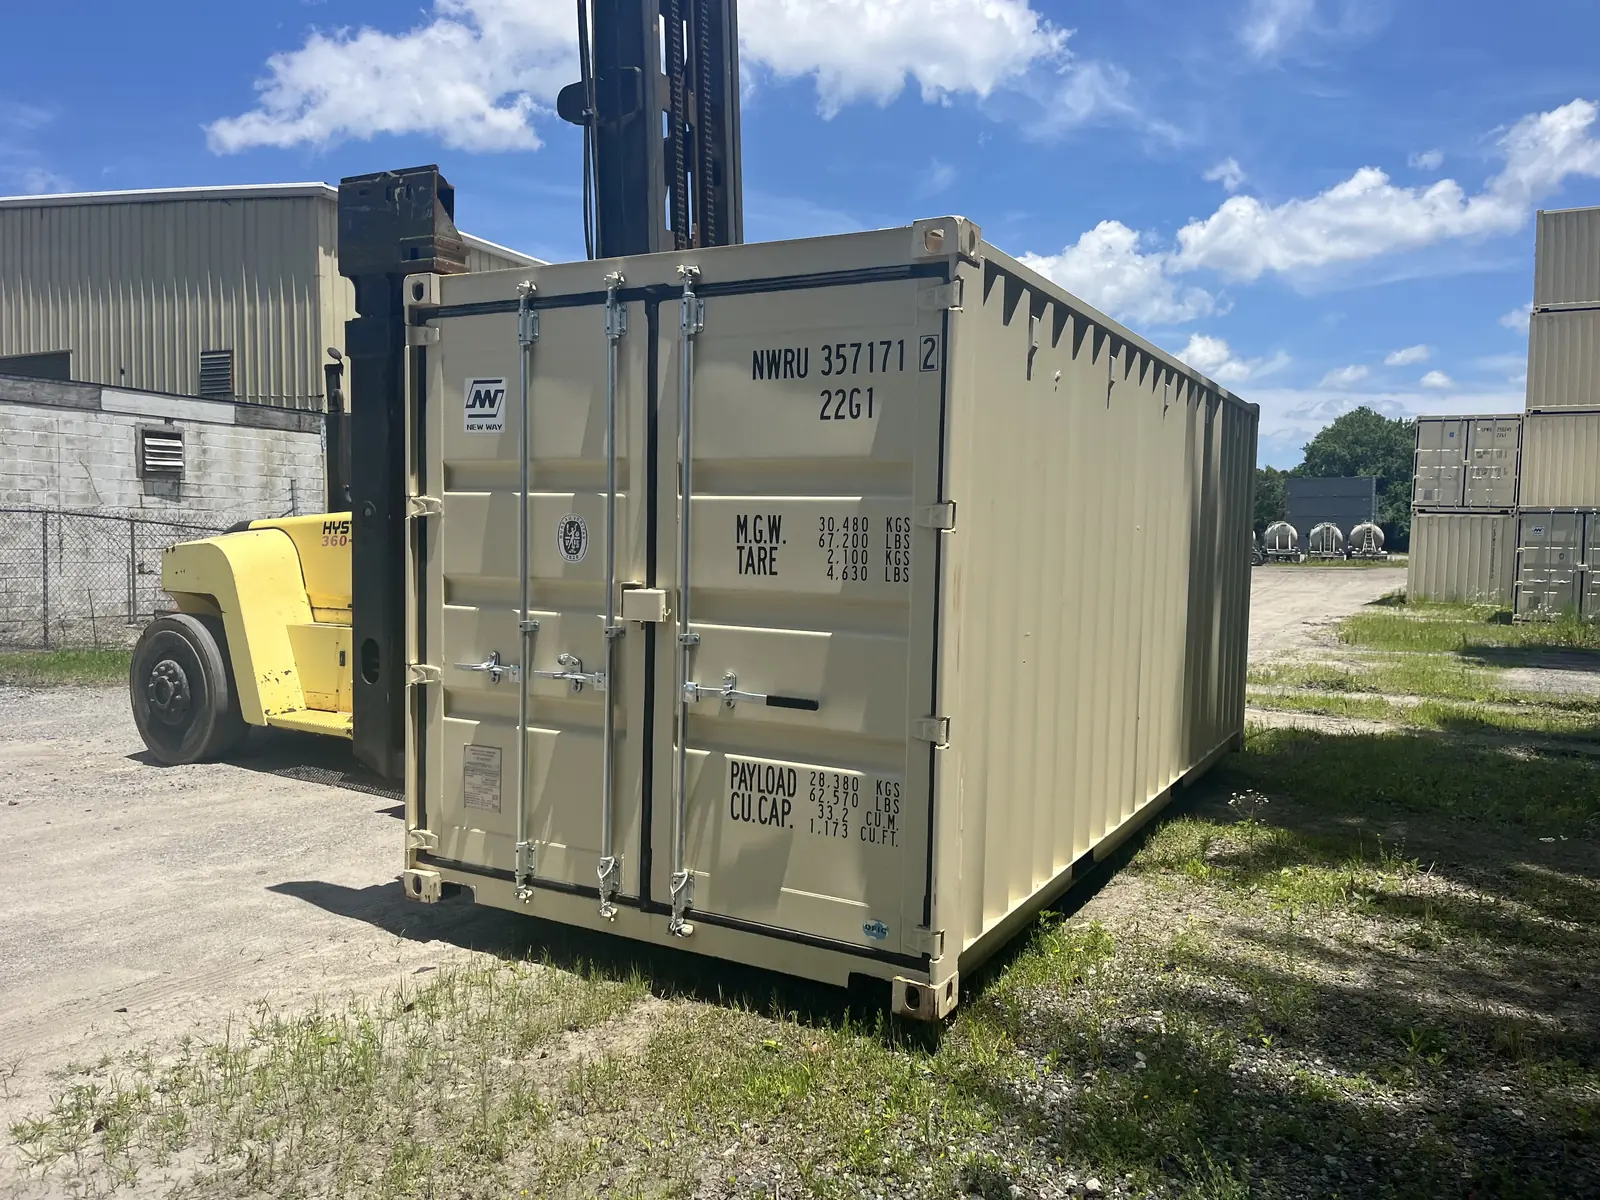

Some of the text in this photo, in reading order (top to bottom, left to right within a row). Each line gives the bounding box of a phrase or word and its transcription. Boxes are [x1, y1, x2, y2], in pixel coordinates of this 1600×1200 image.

[752, 337, 936, 380] NWRU 357171 2
[819, 387, 873, 420] 22G1
[322, 520, 352, 535] HYS
[736, 514, 787, 544] M.G.W.
[819, 516, 911, 533] 30,480 KGS
[818, 533, 910, 550] 67,200 LBS
[736, 546, 778, 576] TARE
[827, 549, 910, 566] 2,100 KGS
[826, 565, 910, 583] 4,630 LBS
[730, 761, 797, 798] PAYLOAD
[809, 771, 900, 798] 28,380 KGS
[730, 791, 794, 829] CU.CAP.
[809, 788, 900, 814] 62,570 LBS
[818, 804, 849, 823] 33.2
[809, 818, 848, 839] 1,173
